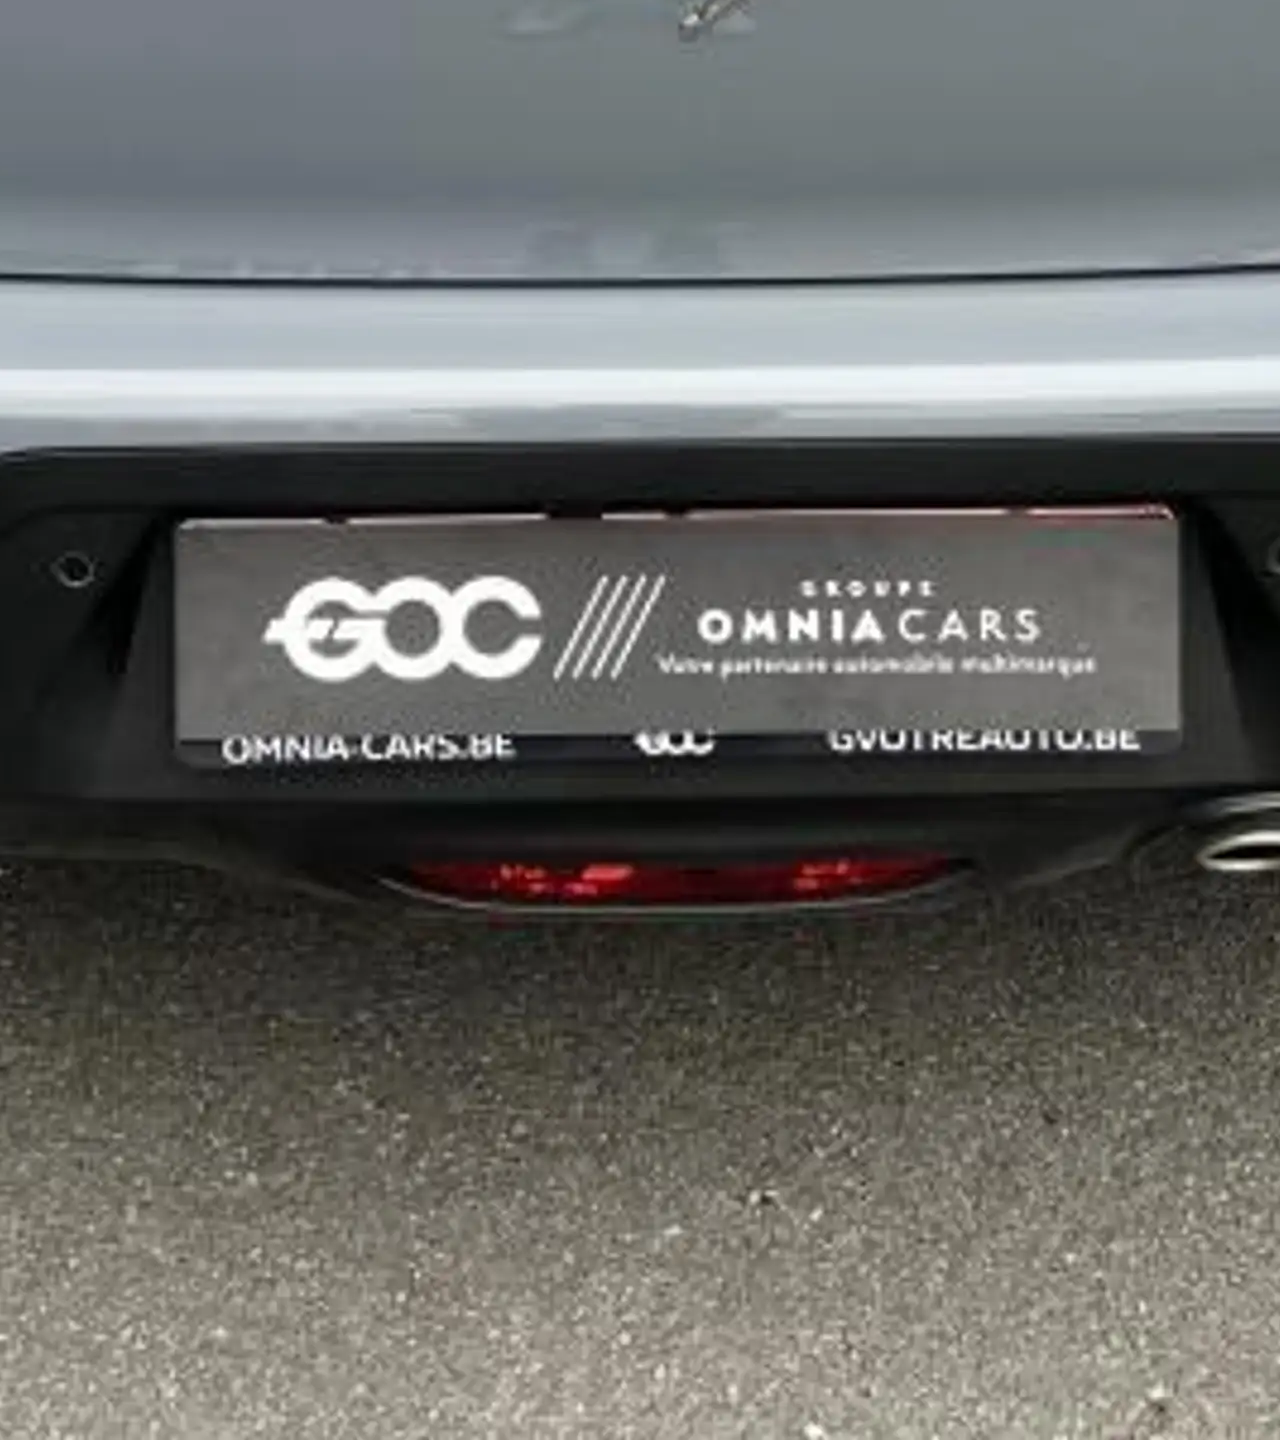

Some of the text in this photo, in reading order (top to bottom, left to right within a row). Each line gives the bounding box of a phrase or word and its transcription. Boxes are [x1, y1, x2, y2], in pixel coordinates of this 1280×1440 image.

[800, 579, 936, 598] GROUPE
[697, 608, 1042, 644] OMNIA CARS
[656, 651, 1098, 683] Votre partenaire automobile multimarque
